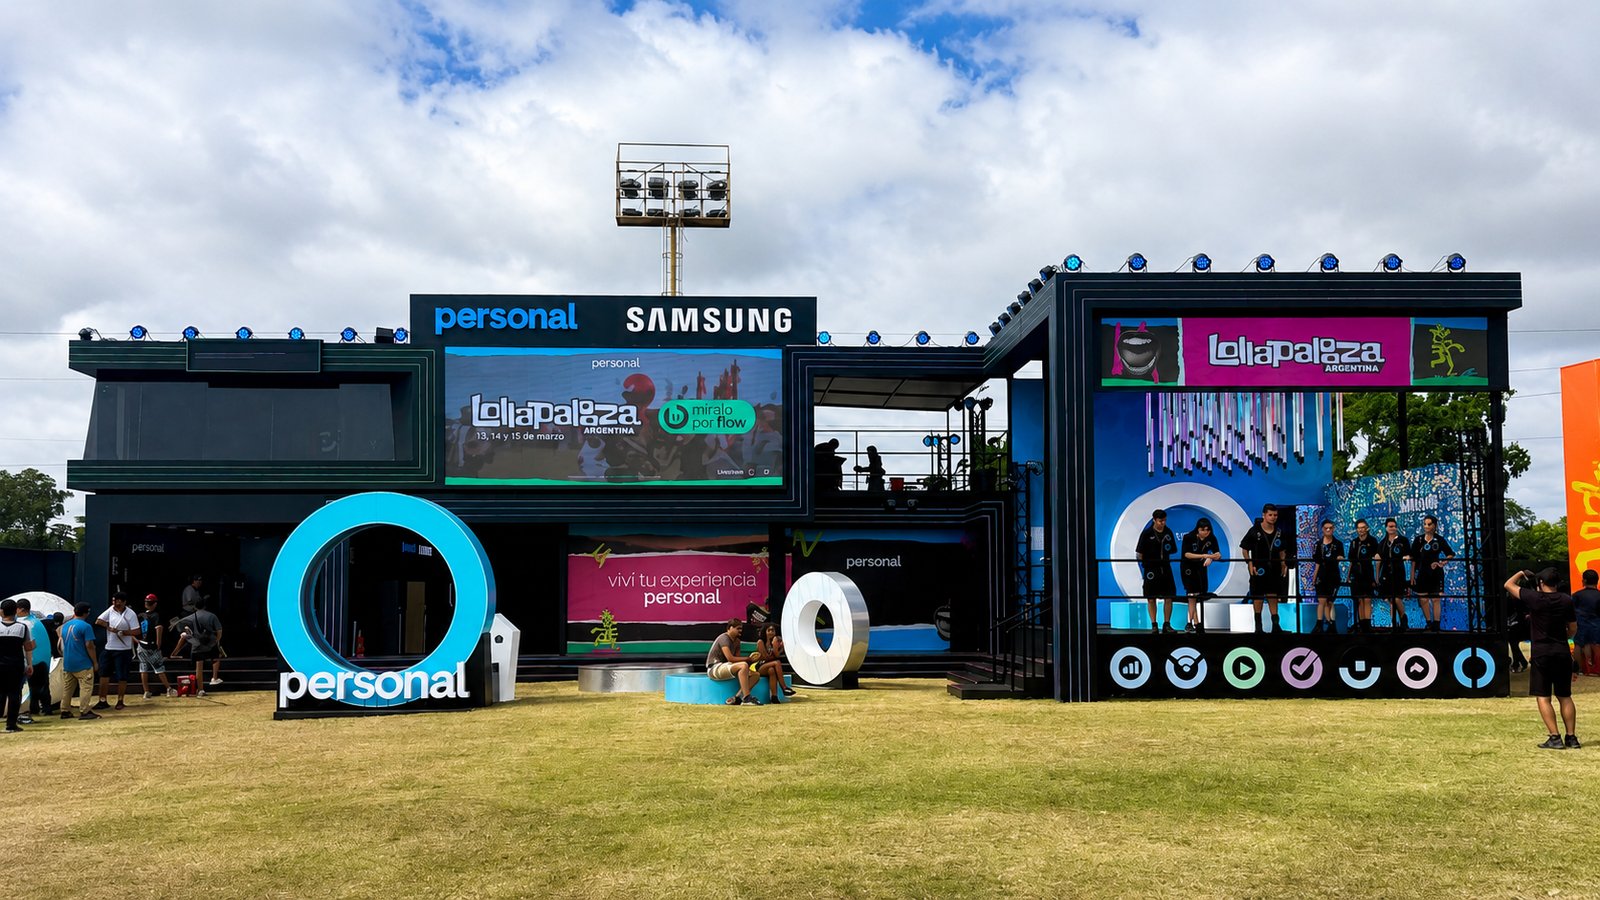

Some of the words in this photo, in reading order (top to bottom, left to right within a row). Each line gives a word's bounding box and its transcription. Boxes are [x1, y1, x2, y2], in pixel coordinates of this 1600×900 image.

[435, 303, 577, 335] personal
[626, 306, 792, 333] SAMSUNG
[1208, 333, 1386, 368] Lollapalooza
[592, 357, 641, 369] personal
[1325, 364, 1379, 373] ARGENTINA
[471, 394, 642, 430] Lollapalooza
[692, 403, 733, 415] miralo
[692, 419, 714, 430] por
[717, 416, 746, 428] flow
[476, 432, 489, 441] 13,
[490, 432, 500, 440] 14
[503, 433, 508, 441] y
[511, 432, 521, 440] 15
[523, 432, 534, 440] de
[536, 433, 565, 441] marzo
[584, 427, 635, 435] ARGENTINA
[131, 543, 165, 554] personal
[846, 555, 902, 570] personal
[639, 573, 656, 587] tu
[660, 571, 757, 590] experiencia
[644, 588, 722, 608] personal
[279, 661, 471, 708] personal
